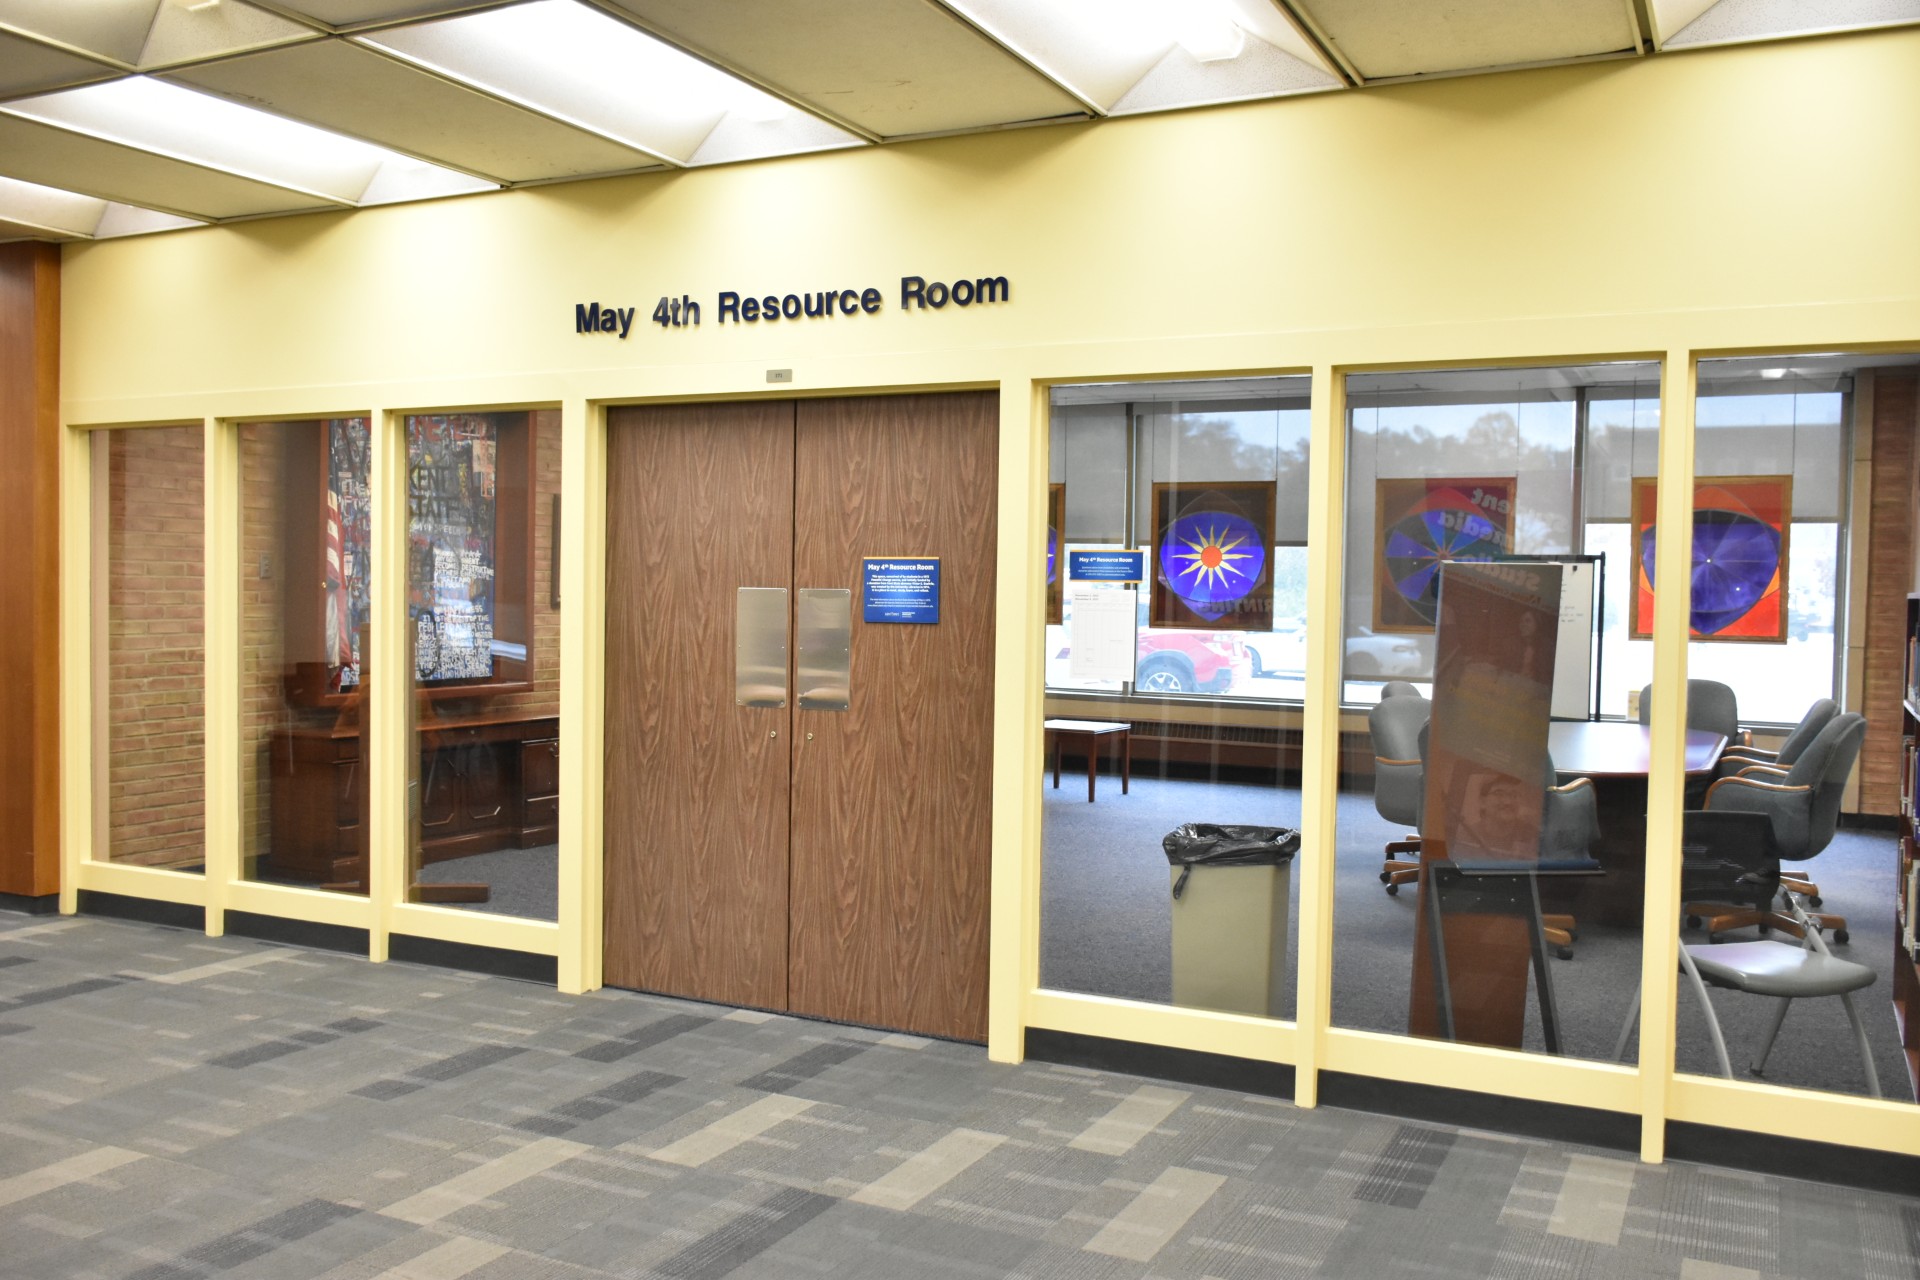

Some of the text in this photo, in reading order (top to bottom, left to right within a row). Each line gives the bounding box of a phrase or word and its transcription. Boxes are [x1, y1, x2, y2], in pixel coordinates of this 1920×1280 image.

[575, 276, 1010, 338] May 4th Resource Room
